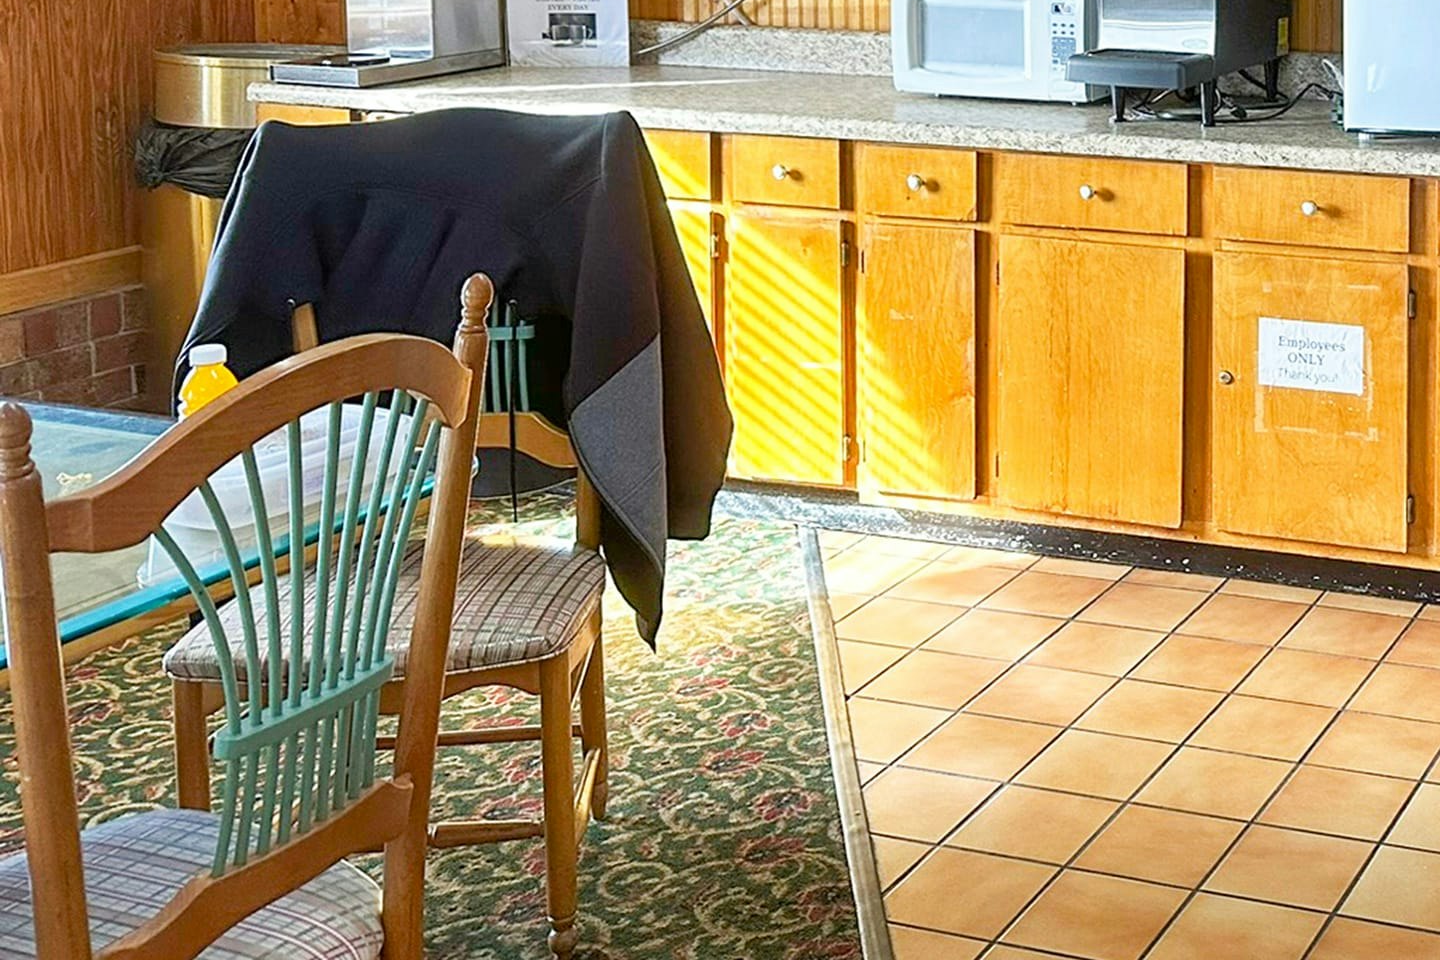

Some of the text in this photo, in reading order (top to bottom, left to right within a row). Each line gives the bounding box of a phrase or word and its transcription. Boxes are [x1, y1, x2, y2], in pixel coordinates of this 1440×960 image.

[1278, 335, 1346, 352] Employees
[1287, 352, 1326, 366] ONLY
[1278, 367, 1313, 381] Thank
